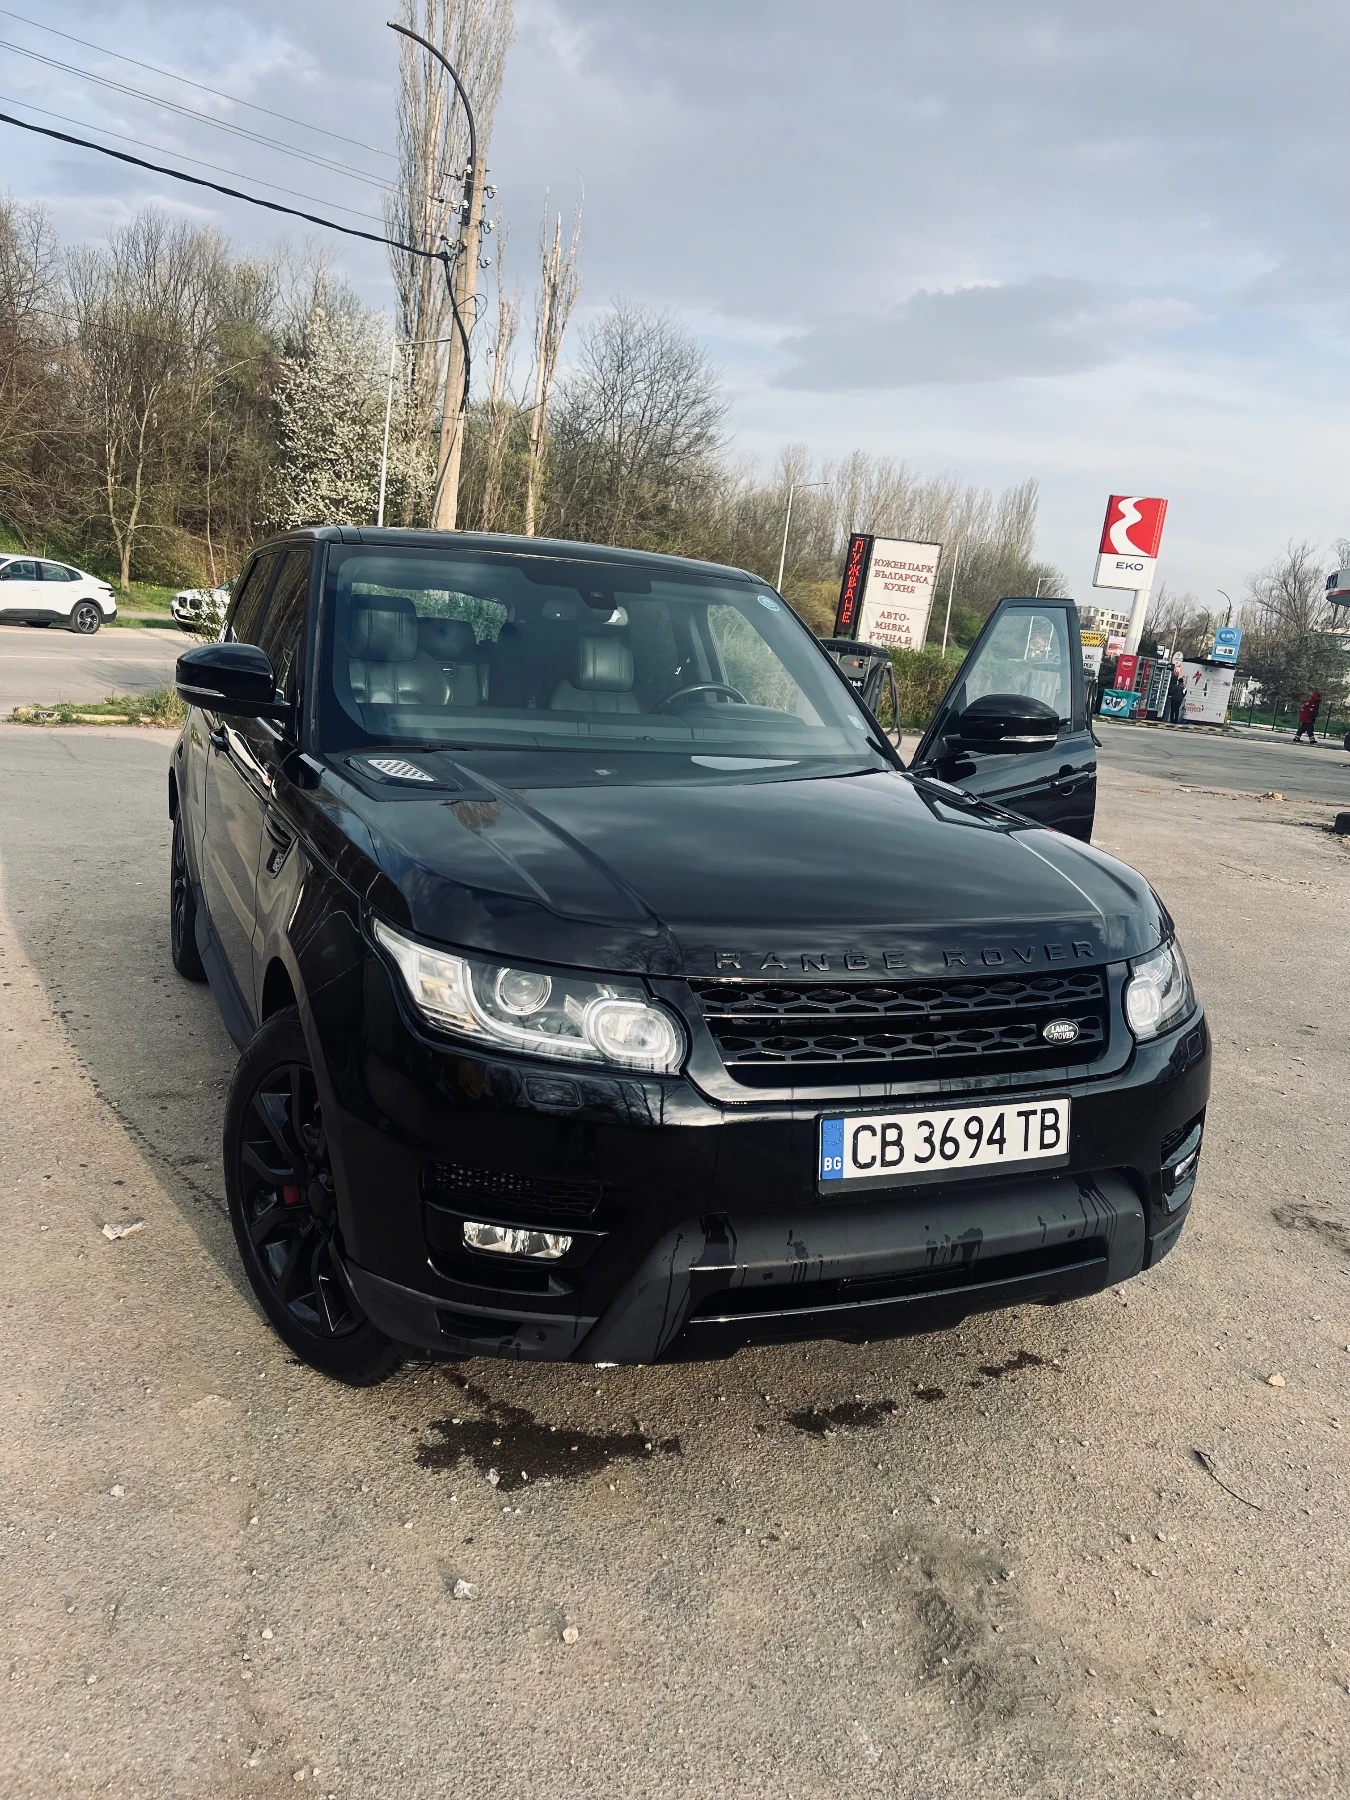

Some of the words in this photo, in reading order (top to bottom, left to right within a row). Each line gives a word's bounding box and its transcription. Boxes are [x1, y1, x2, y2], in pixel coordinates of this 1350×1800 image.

[873, 559, 907, 570] ЮЖЕН
[907, 563, 934, 573] ПАРК
[1115, 561, 1144, 571] EKO
[883, 583, 916, 593] КУХНЯ
[879, 610, 910, 621] АВТО-
[874, 621, 911, 633] МИВКА
[715, 950, 908, 972] RANGE
[943, 941, 1095, 967] ROVER
[1051, 1025, 1069, 1033] LAND
[1053, 1031, 1074, 1039] ROVER
[823, 1156, 842, 1172] BG
[852, 1122, 905, 1169] CB
[914, 1112, 1007, 1164] 3694
[1017, 1107, 1062, 1152] TB
